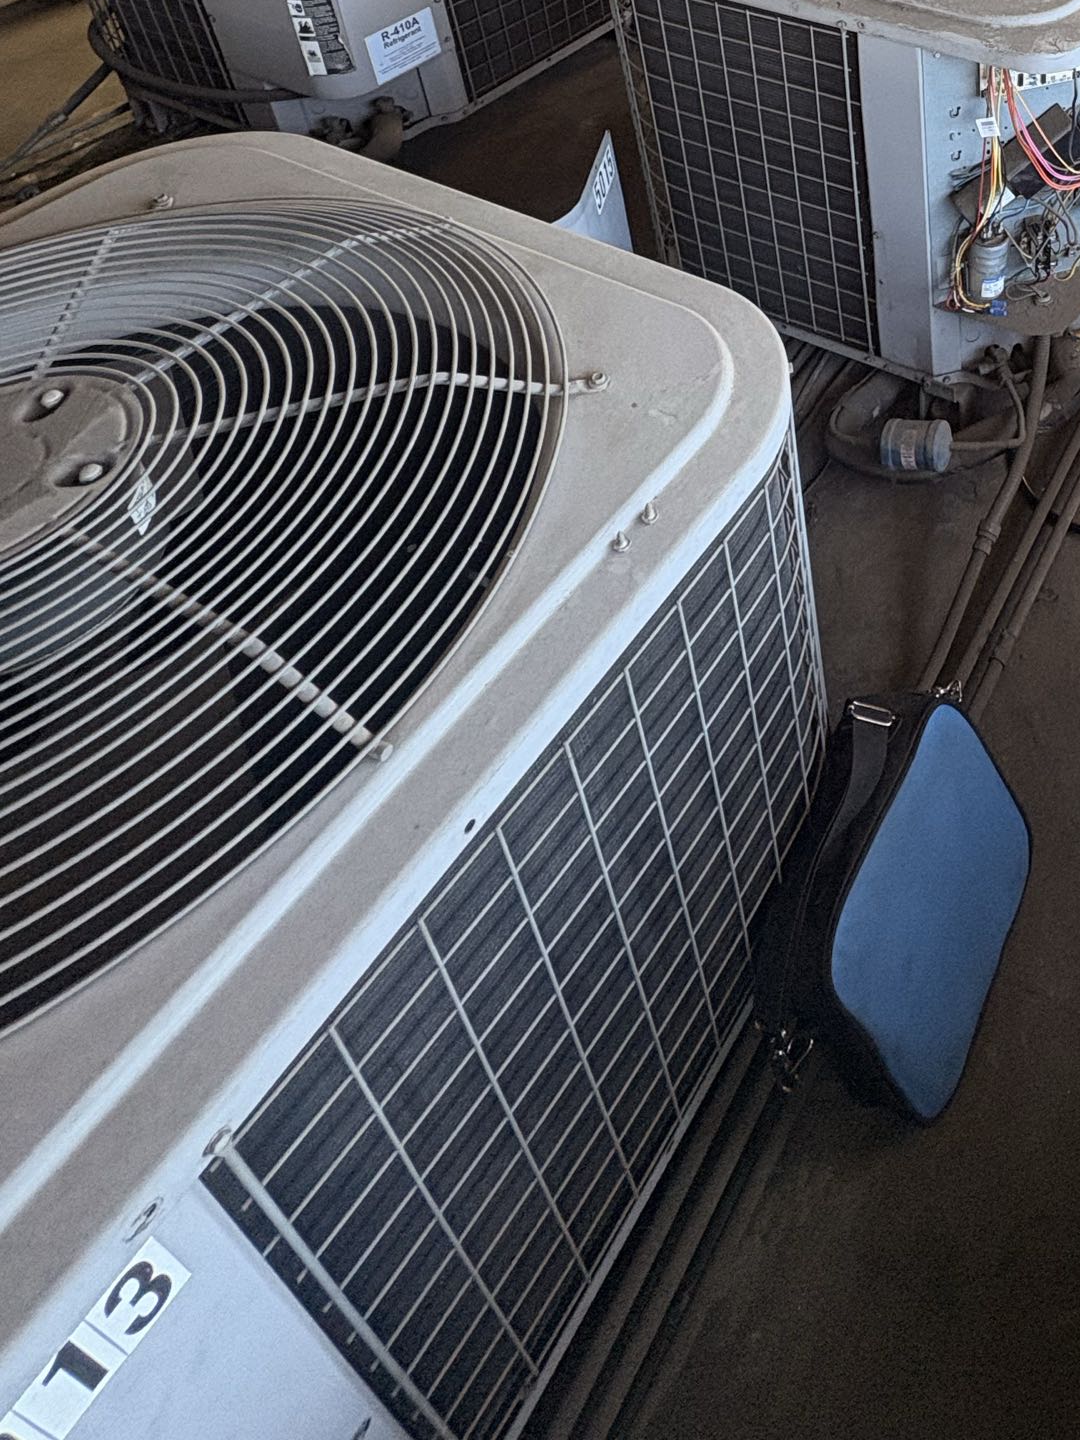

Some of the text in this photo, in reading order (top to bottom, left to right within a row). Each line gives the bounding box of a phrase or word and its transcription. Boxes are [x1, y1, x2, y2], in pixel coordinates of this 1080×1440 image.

[381, 17, 420, 42] R-410A
[383, 26, 422, 49] Refrigerant
[0, 1260, 173, 1440] 13
